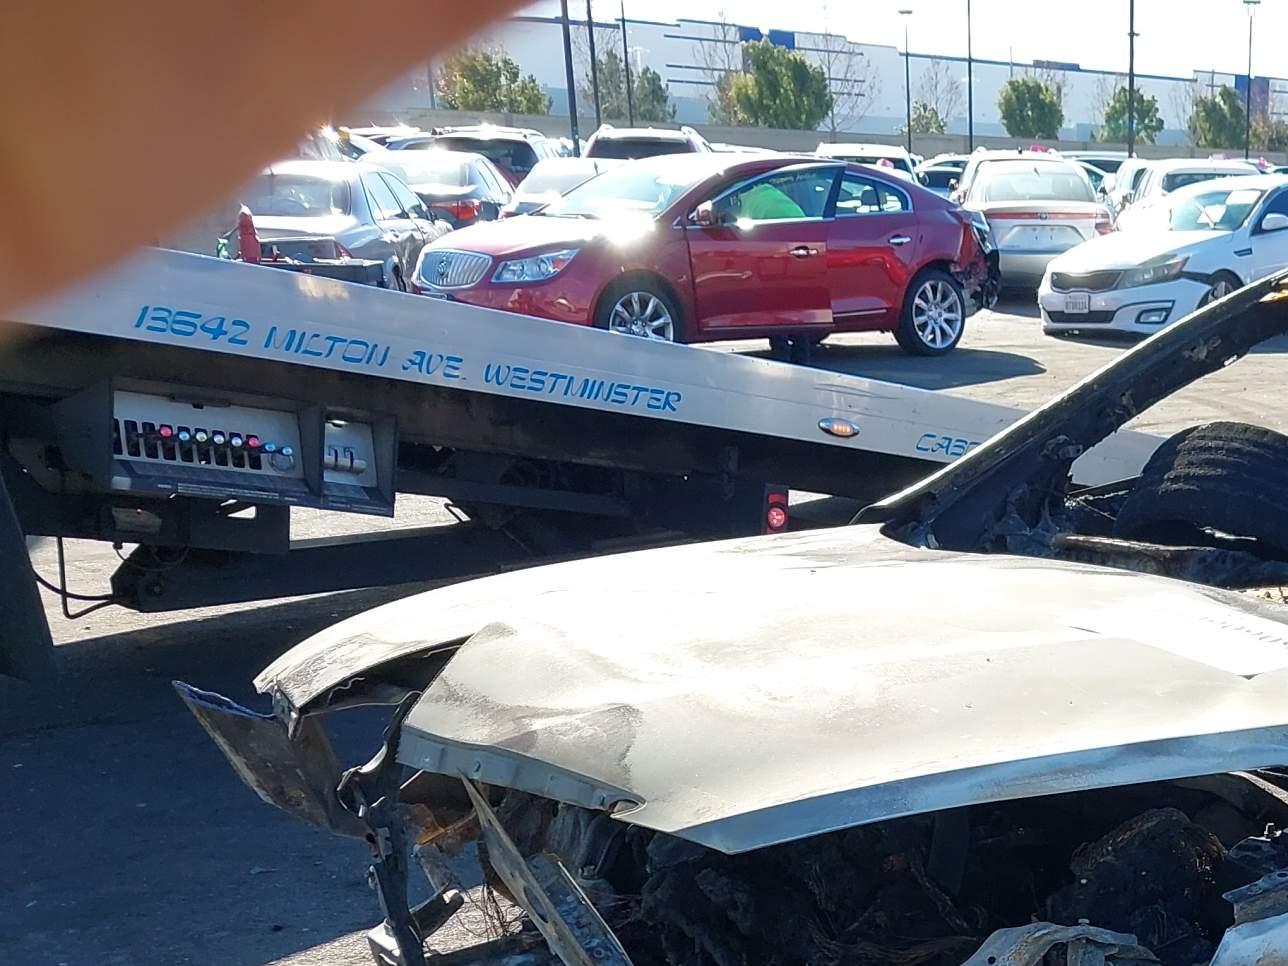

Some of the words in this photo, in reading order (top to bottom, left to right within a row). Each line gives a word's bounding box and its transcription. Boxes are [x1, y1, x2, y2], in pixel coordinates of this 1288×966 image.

[135, 305, 250, 345] 13642
[263, 326, 391, 367] MILTON
[401, 350, 467, 381] AVE.
[483, 362, 682, 412] WESTMINSTER
